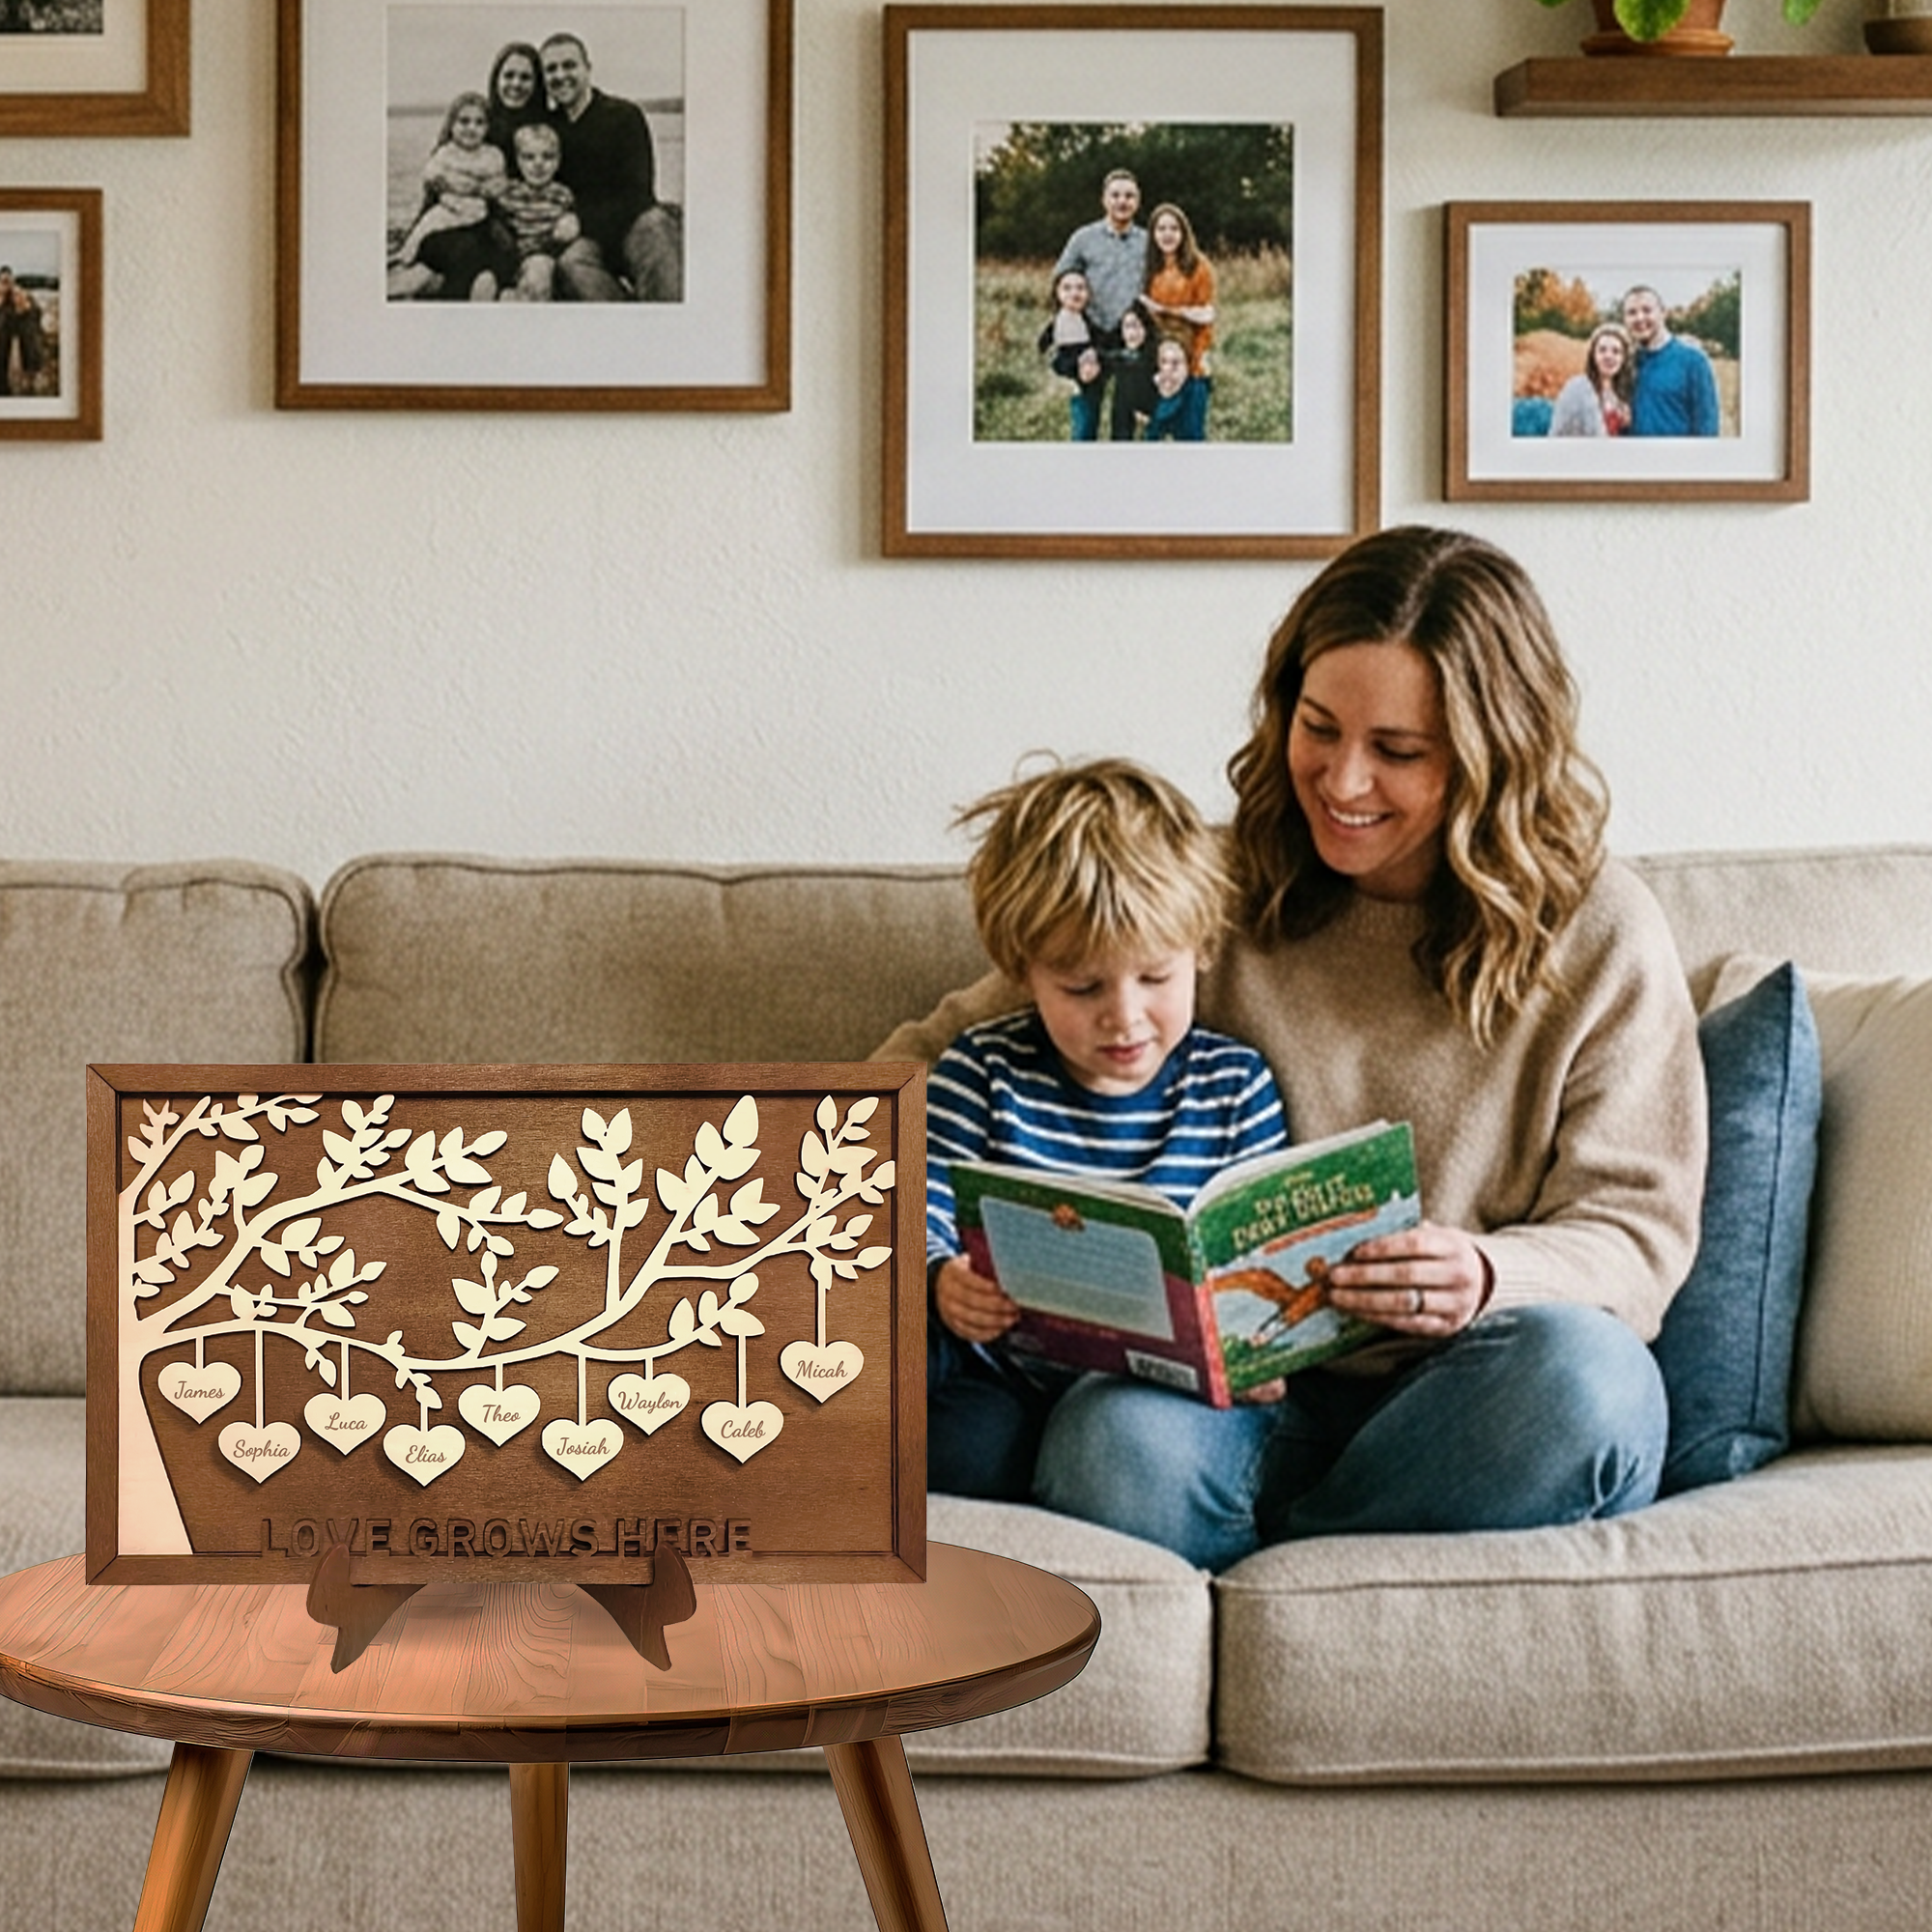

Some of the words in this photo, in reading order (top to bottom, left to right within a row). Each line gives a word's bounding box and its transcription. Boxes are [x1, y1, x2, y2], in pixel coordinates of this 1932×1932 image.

[795, 1360, 848, 1378] Micah
[174, 1380, 225, 1399] James
[618, 1391, 682, 1414] Waylon
[325, 1412, 367, 1431] Luca
[483, 1405, 521, 1423] Theo
[721, 1420, 766, 1438] Caleb
[233, 1439, 290, 1462] Sophia
[406, 1445, 446, 1463] Elias
[556, 1437, 610, 1456] Josiah
[262, 1518, 391, 1557] LOVE
[409, 1518, 599, 1557] GROWS
[616, 1518, 753, 1557] HERE
